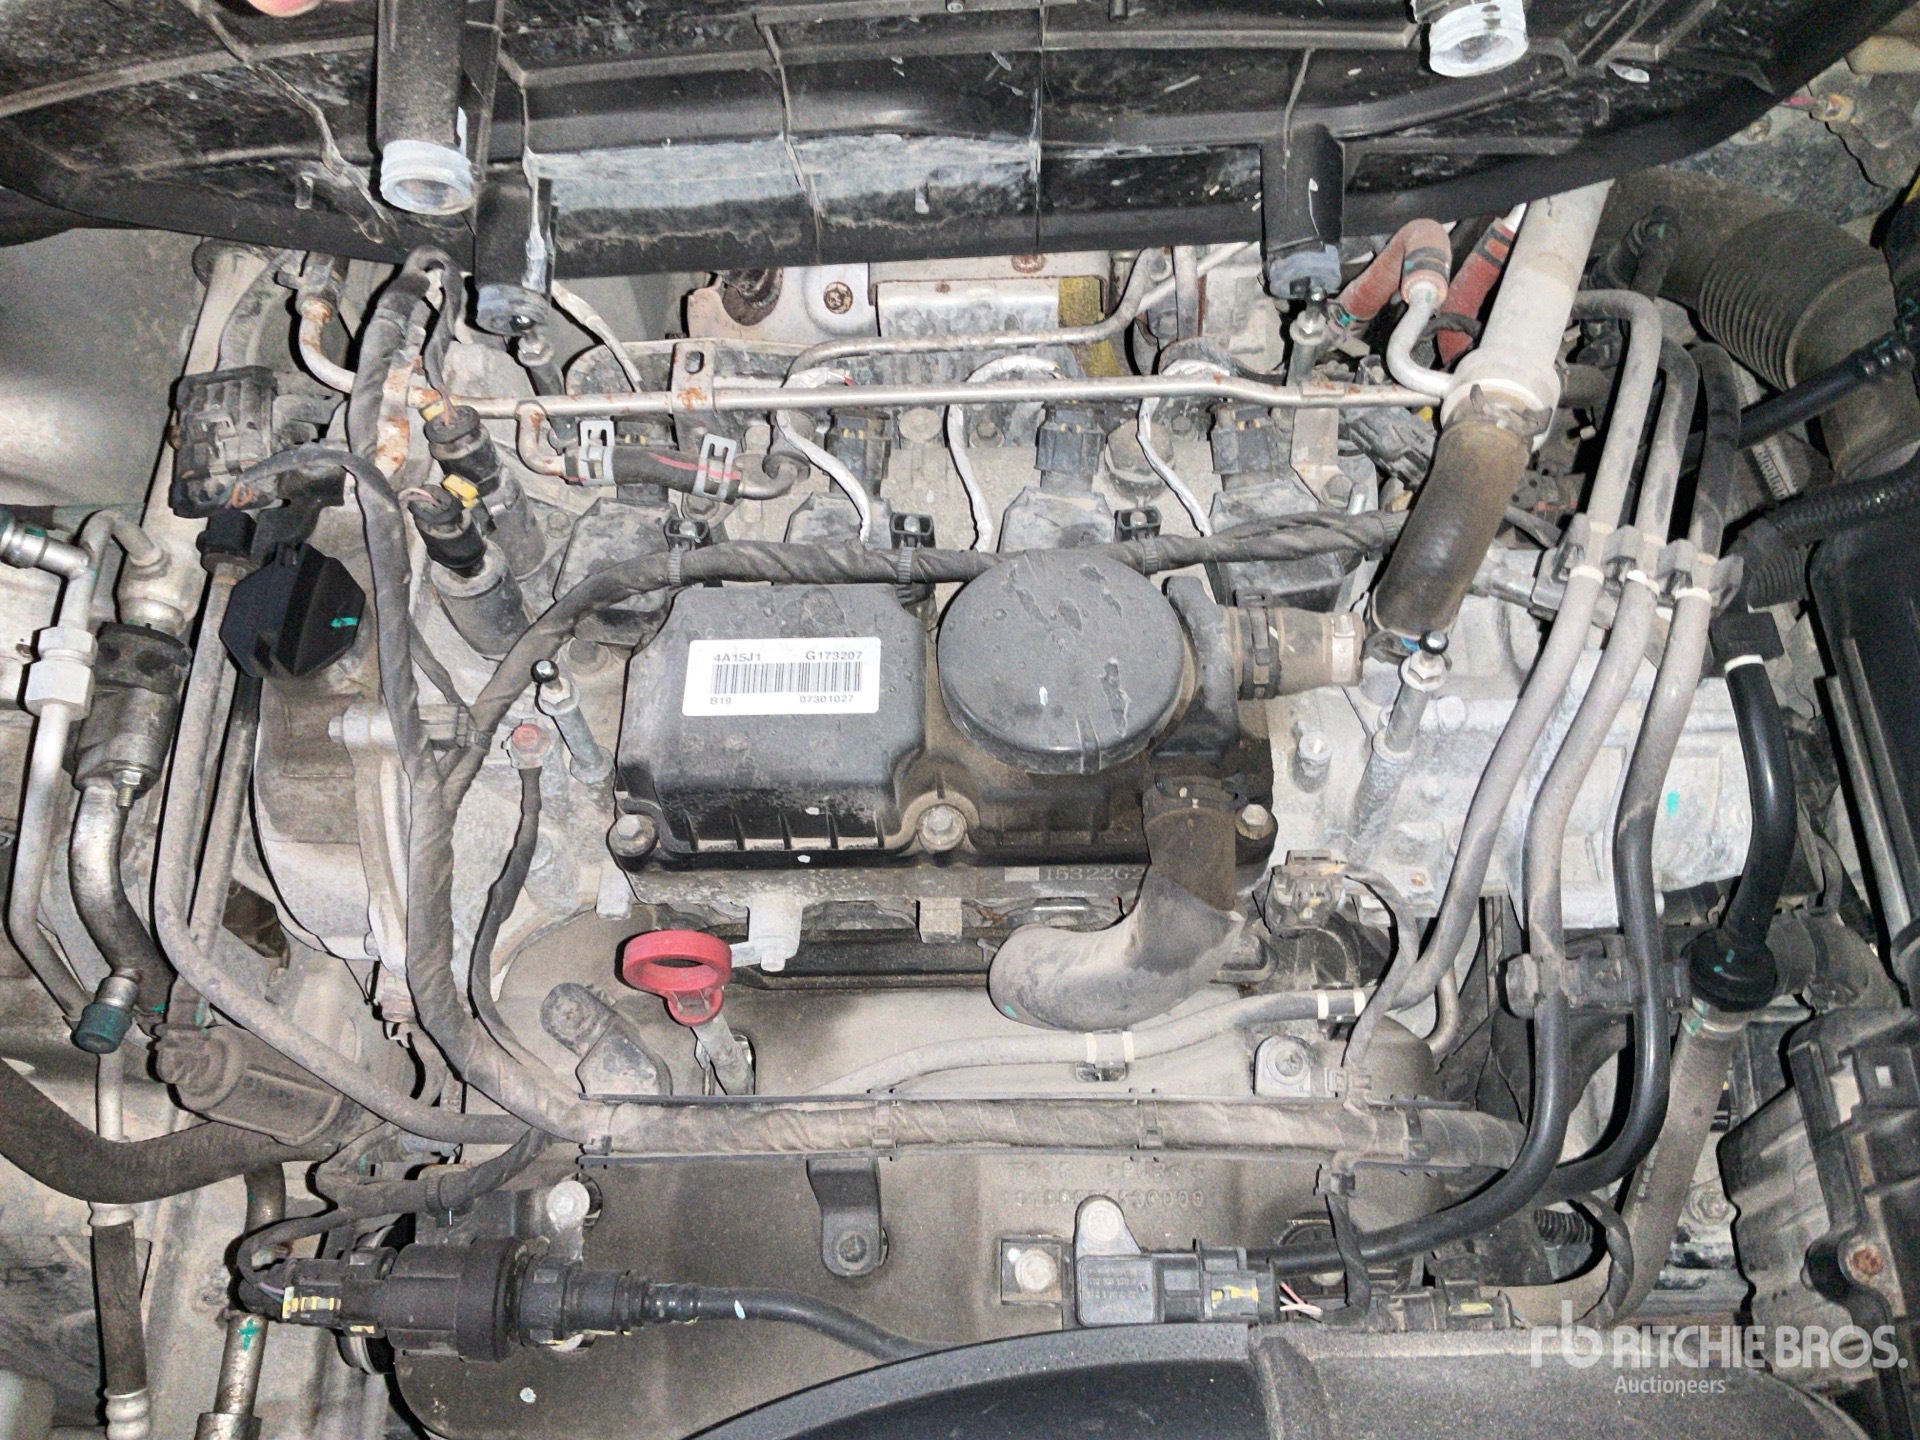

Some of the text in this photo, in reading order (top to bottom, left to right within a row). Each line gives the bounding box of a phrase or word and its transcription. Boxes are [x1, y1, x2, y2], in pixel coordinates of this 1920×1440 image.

[713, 650, 863, 662] 4A15J1 G173207
[709, 694, 855, 705] B19 07301027
